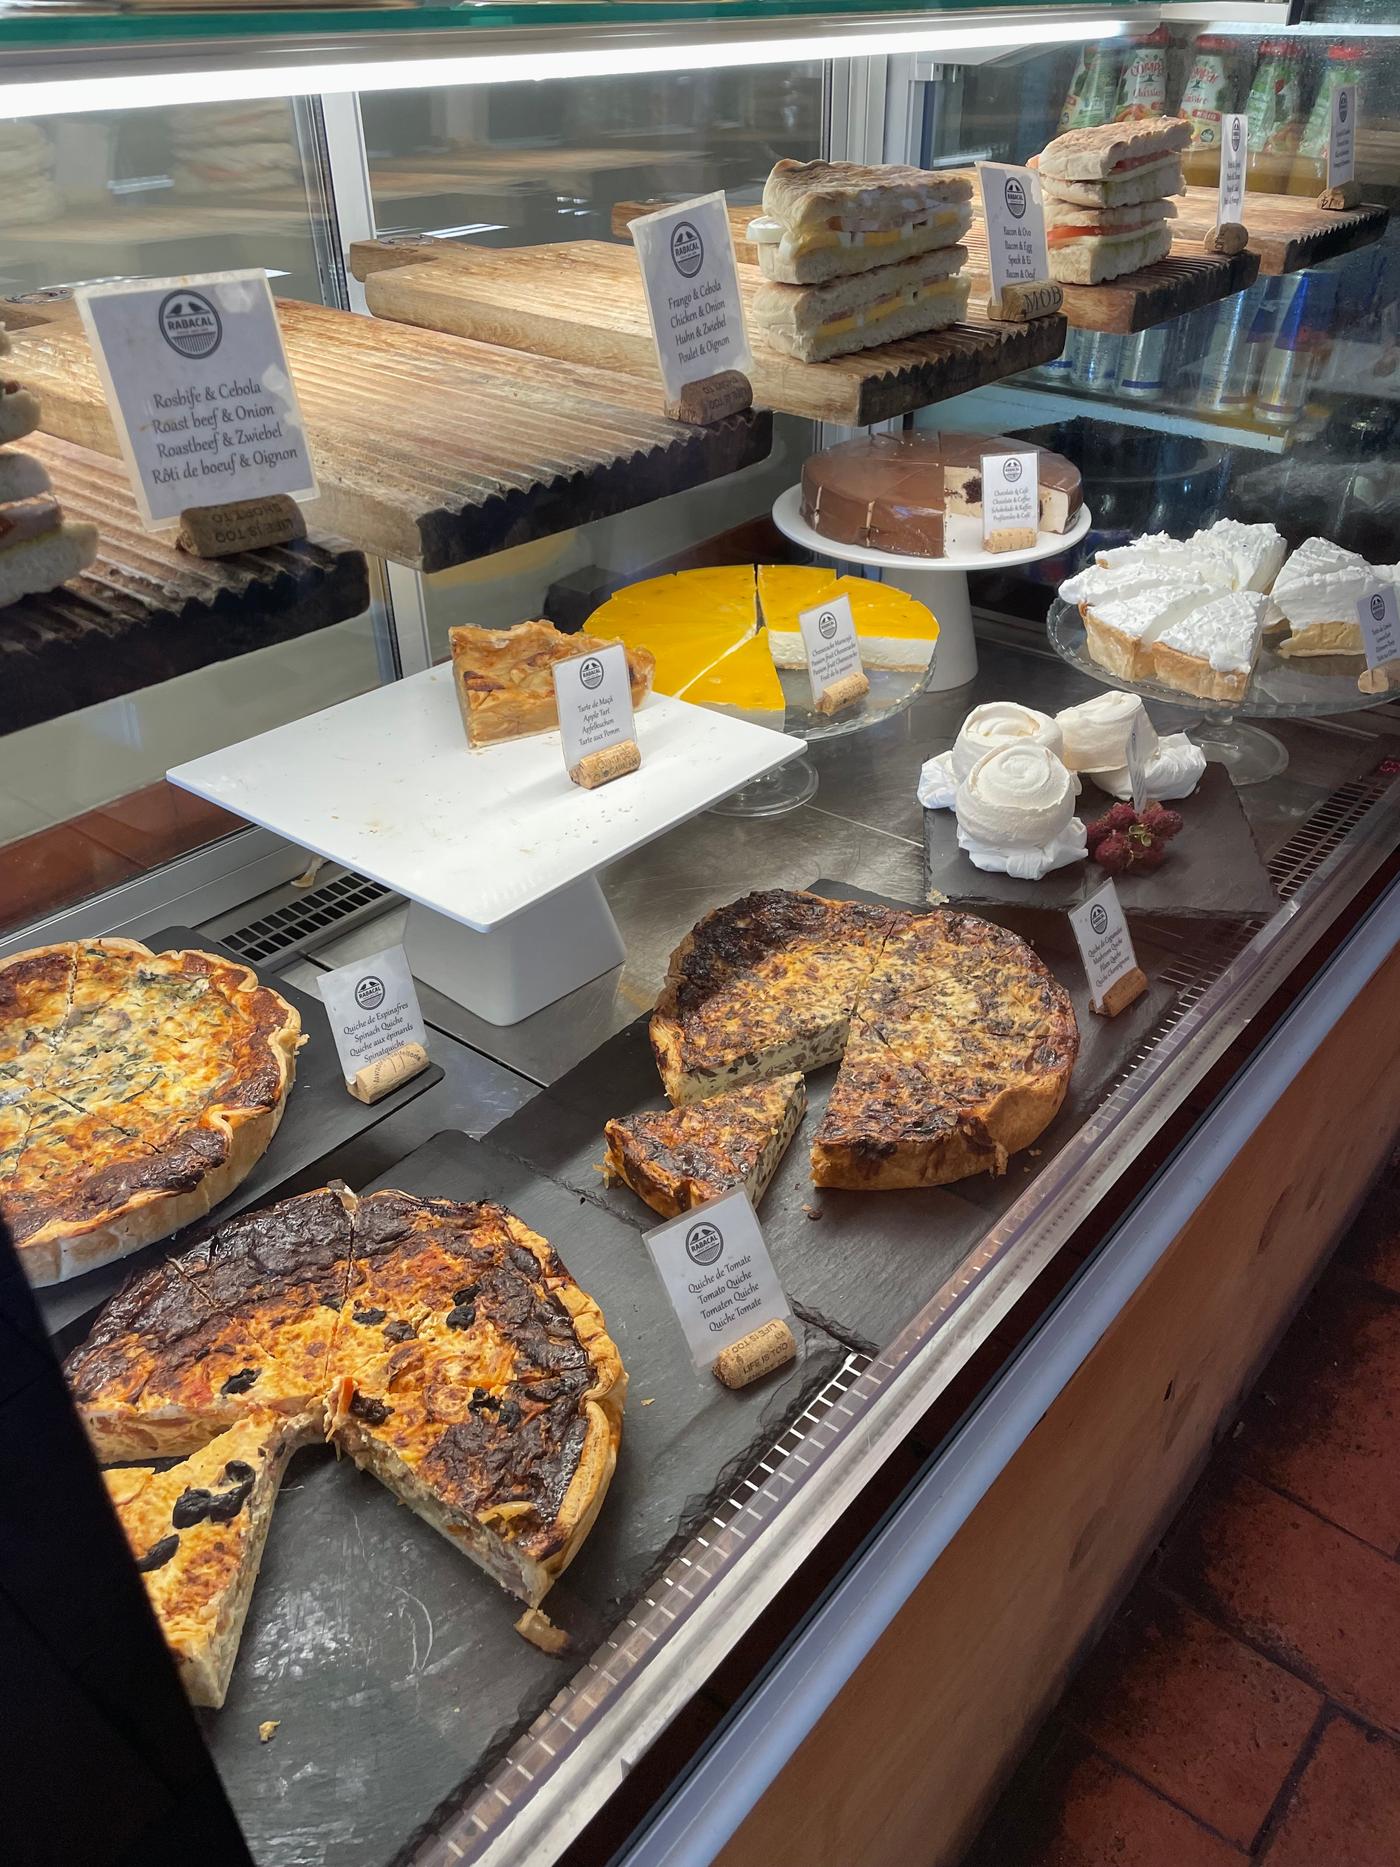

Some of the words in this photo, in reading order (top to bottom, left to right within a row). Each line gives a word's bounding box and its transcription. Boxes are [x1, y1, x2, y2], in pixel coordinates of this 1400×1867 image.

[668, 294, 692, 310] Frango
[693, 288, 700, 300] &
[700, 278, 722, 297] Cebola
[671, 310, 698, 328] Chicken
[699, 306, 704, 317] &
[705, 300, 725, 314] Onion
[676, 330, 694, 346] Huhn
[696, 326, 702, 338] &
[703, 313, 726, 335] Zwiebel
[678, 346, 699, 366] Poulet
[700, 344, 706, 355] &
[706, 336, 730, 353] Oignon
[153, 386, 201, 410] Rosbife
[205, 386, 217, 401] &
[219, 378, 261, 399] Cebola
[152, 416, 189, 434] Roast
[191, 407, 218, 430] beef
[222, 408, 233, 423] &
[236, 403, 274, 420] Onion
[157, 432, 219, 458] Roastbeef
[223, 432, 234, 447] &
[235, 421, 283, 444] Zwiebel
[152, 465, 180, 484] Rôti
[183, 461, 198, 479] de
[201, 452, 237, 476] boeuf
[240, 454, 252, 468] &
[253, 448, 298, 468] Oignon
[584, 710, 599, 723] Apple
[600, 708, 610, 716] Tart
[592, 699, 598, 708] de
[344, 1020, 366, 1035] Quiche
[368, 1015, 375, 1024] de
[376, 1002, 408, 1020] Espinafres
[355, 1025, 380, 1043] Spinach
[381, 1016, 403, 1030] Quiche
[350, 1042, 372, 1056] Quiche
[374, 1037, 385, 1046] aux
[386, 1022, 413, 1042] épinards
[364, 1040, 404, 1063] Spinatquiche
[688, 1275, 715, 1293] Quiche
[716, 1267, 725, 1279] de
[724, 1255, 751, 1273] Tomate
[697, 1286, 726, 1305] Tomato
[727, 1271, 752, 1289] Quiche
[700, 1299, 733, 1320] Tomaten
[734, 1282, 759, 1301] Quiche
[709, 1313, 735, 1332] Quiche
[735, 1298, 762, 1316] Tomate
[749, 1333, 759, 1341] IS
[759, 1323, 776, 1337] LIFE
[732, 1340, 750, 1353] TOO
[743, 1359, 760, 1374] LIFE
[771, 1342, 788, 1356] TOO
